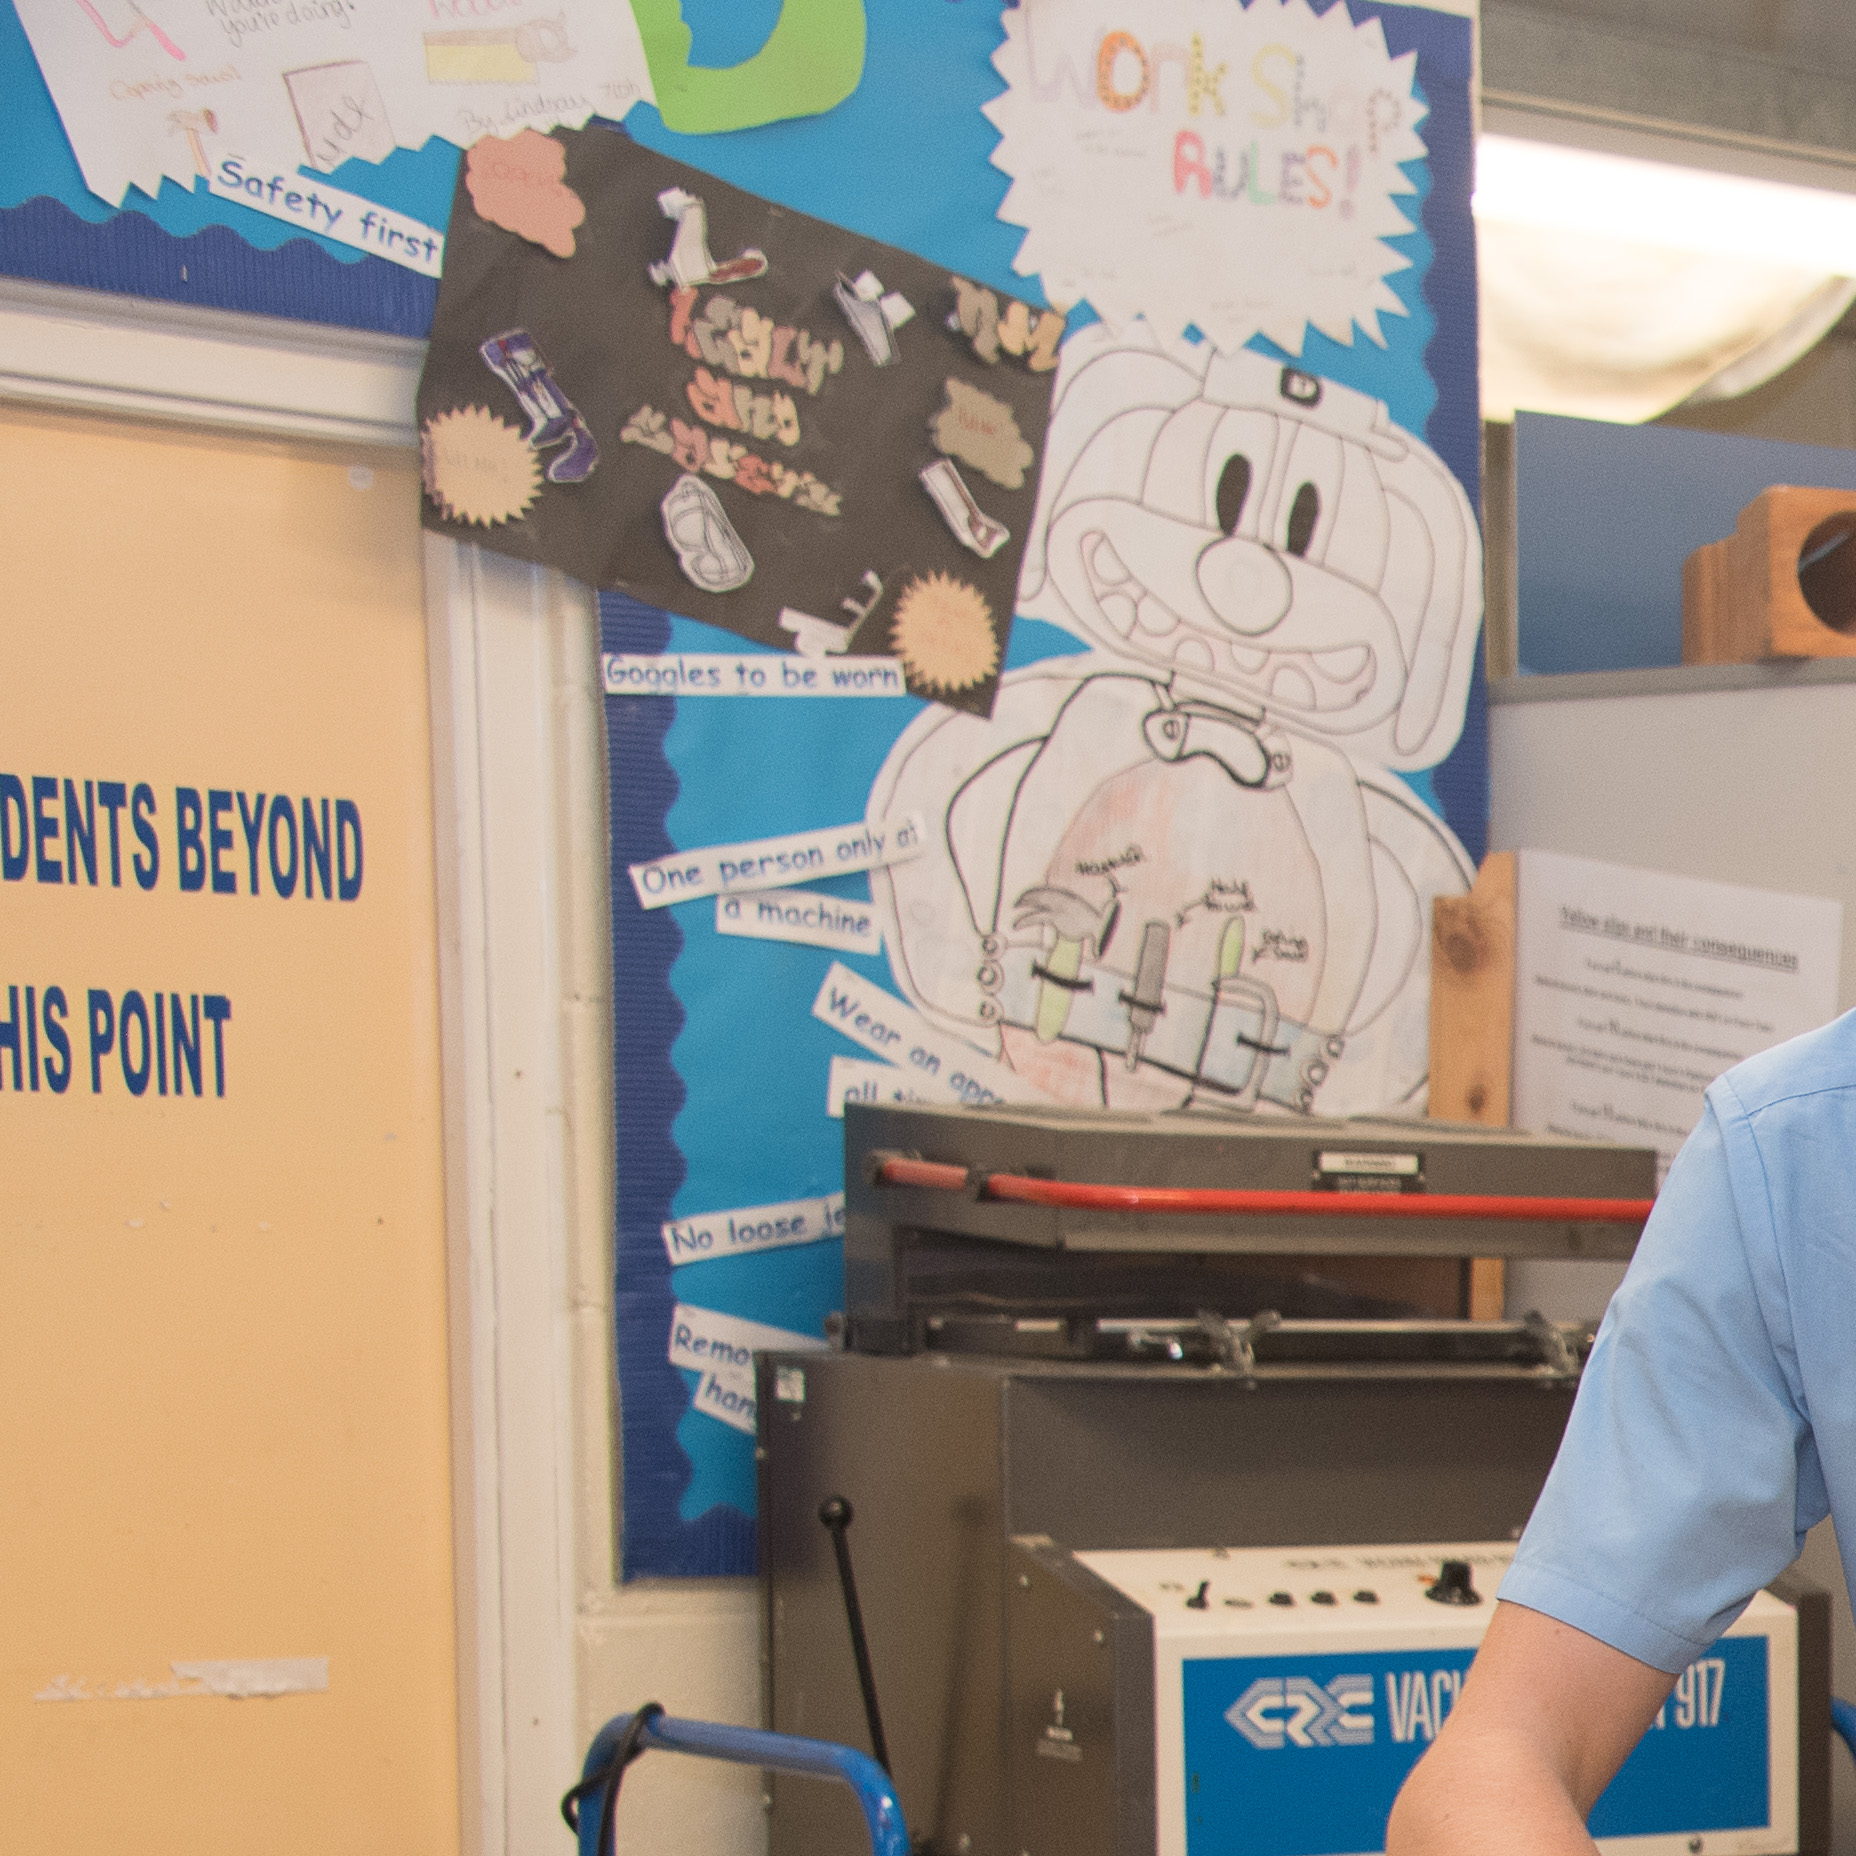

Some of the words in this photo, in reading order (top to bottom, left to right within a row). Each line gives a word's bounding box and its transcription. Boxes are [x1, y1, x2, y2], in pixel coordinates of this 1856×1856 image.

[217, 160, 343, 231] Safety
[360, 206, 438, 263] first
[606, 656, 720, 691] Goggles
[736, 662, 766, 687] to
[782, 661, 817, 688] be
[832, 666, 898, 689] worn
[0, 773, 159, 892] DENTS
[175, 786, 364, 902] BEYOND
[642, 864, 703, 894] One
[718, 846, 825, 884] person
[836, 828, 885, 863] only
[725, 900, 741, 919] a
[757, 901, 871, 937] machine
[87, 987, 231, 1099] POINT
[829, 985, 901, 1047] Wear
[909, 1046, 942, 1076] an
[670, 1223, 713, 1254] No
[728, 1215, 806, 1244] loose
[675, 1323, 750, 1367] Remo
[1674, 1658, 1726, 1729] 917
